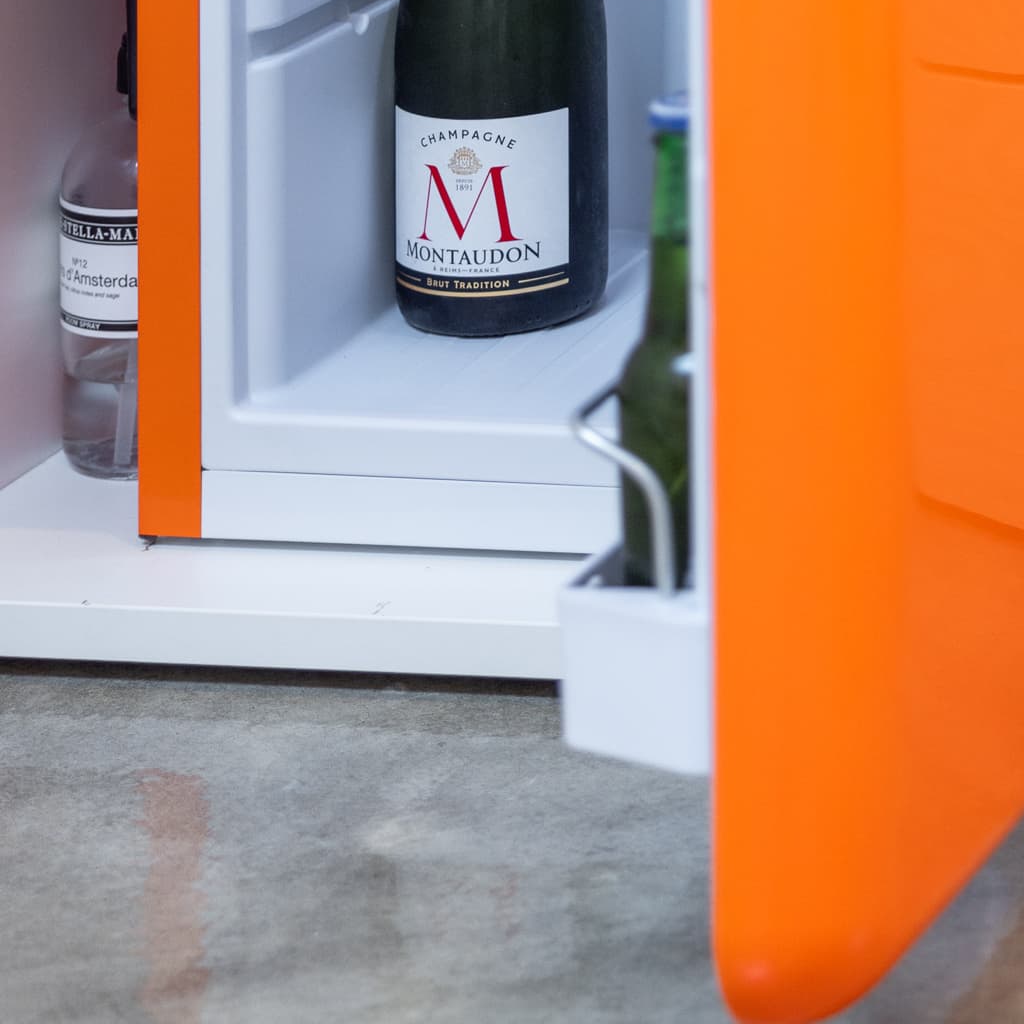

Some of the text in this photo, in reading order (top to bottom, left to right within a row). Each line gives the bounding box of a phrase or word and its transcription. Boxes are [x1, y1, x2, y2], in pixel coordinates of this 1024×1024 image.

[420, 129, 517, 150] CHAMPAGNE
[455, 184, 473, 192] 1891
[417, 164, 524, 243] M
[62, 218, 138, 241] STELLA-MA
[406, 239, 541, 265] MONTAUDON
[426, 277, 510, 290] BRUT TRADITION
[79, 319, 101, 331] SPRAY
